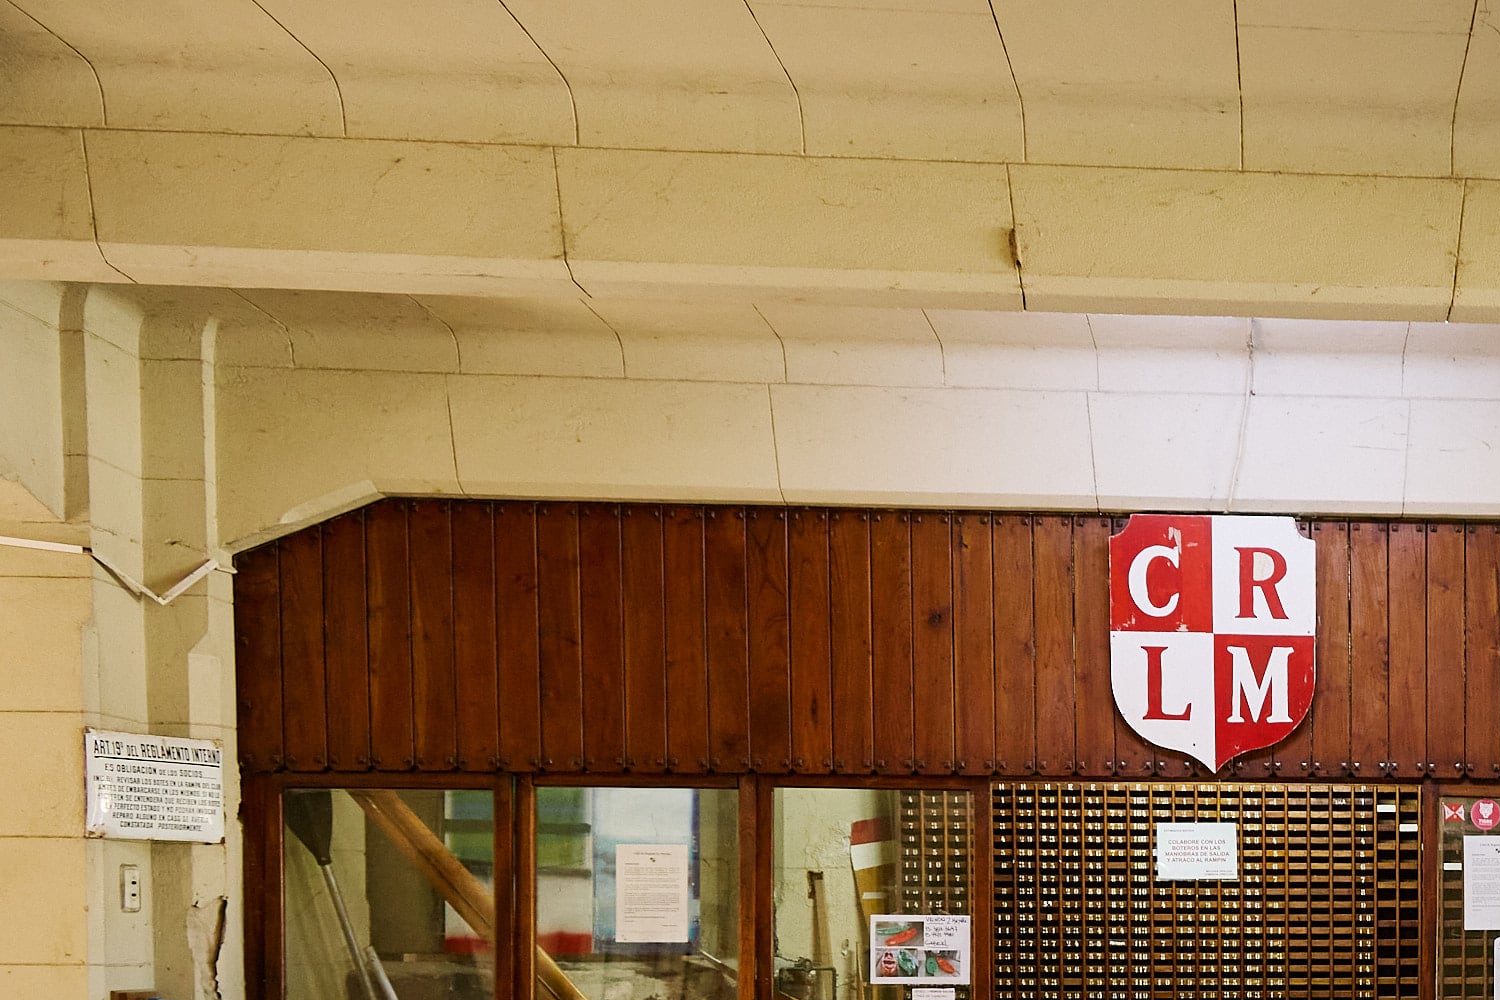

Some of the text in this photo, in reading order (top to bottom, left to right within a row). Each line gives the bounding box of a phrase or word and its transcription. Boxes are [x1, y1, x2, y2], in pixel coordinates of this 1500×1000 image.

[1127, 544, 1289, 620] C R
[1140, 645, 1295, 723] L M
[104, 763, 114, 772] ES
[126, 745, 139, 757] DEL
[140, 743, 190, 761] REGLAMENTO
[191, 747, 220, 764] INTERNO
